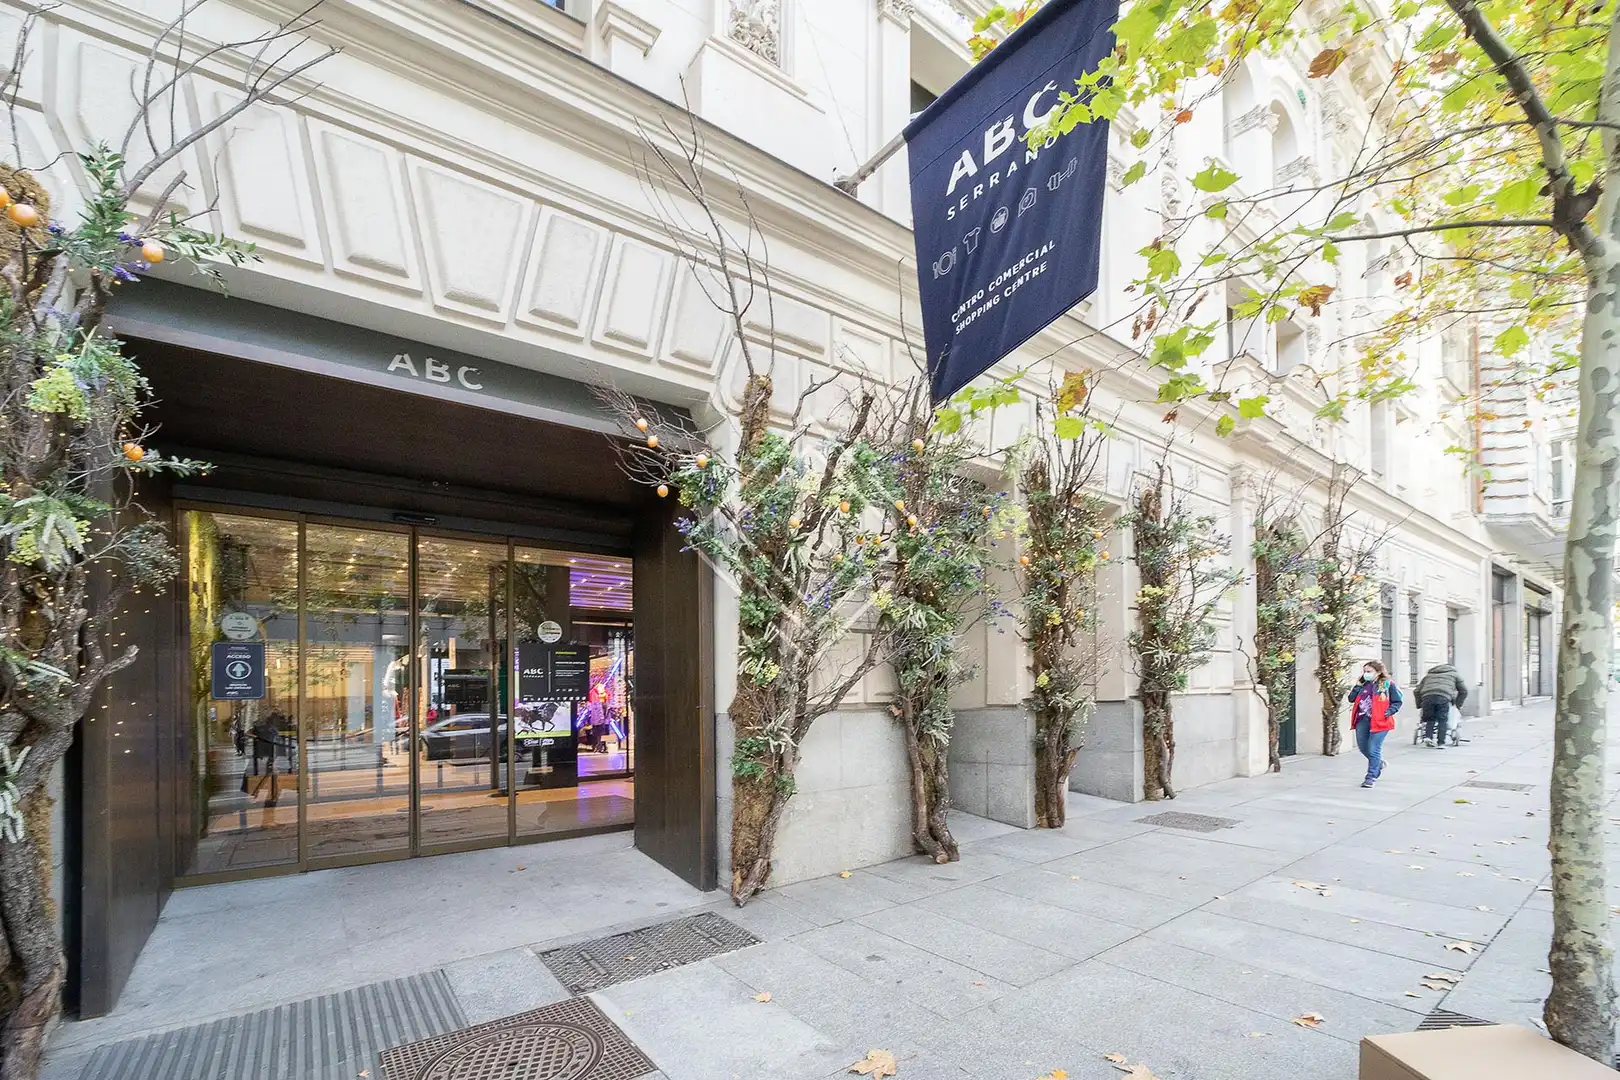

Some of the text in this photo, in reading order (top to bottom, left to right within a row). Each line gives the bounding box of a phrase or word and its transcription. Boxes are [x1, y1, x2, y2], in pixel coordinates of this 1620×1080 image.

[946, 80, 1060, 197] ABC
[947, 134, 1060, 221] SERRANO
[988, 240, 1056, 292] COMERCIAL
[956, 260, 1048, 335] SHOPPING CENTRE
[387, 353, 484, 390] ABC
[523, 667, 544, 675] ABC
[533, 1026, 584, 1044] ISABEL
